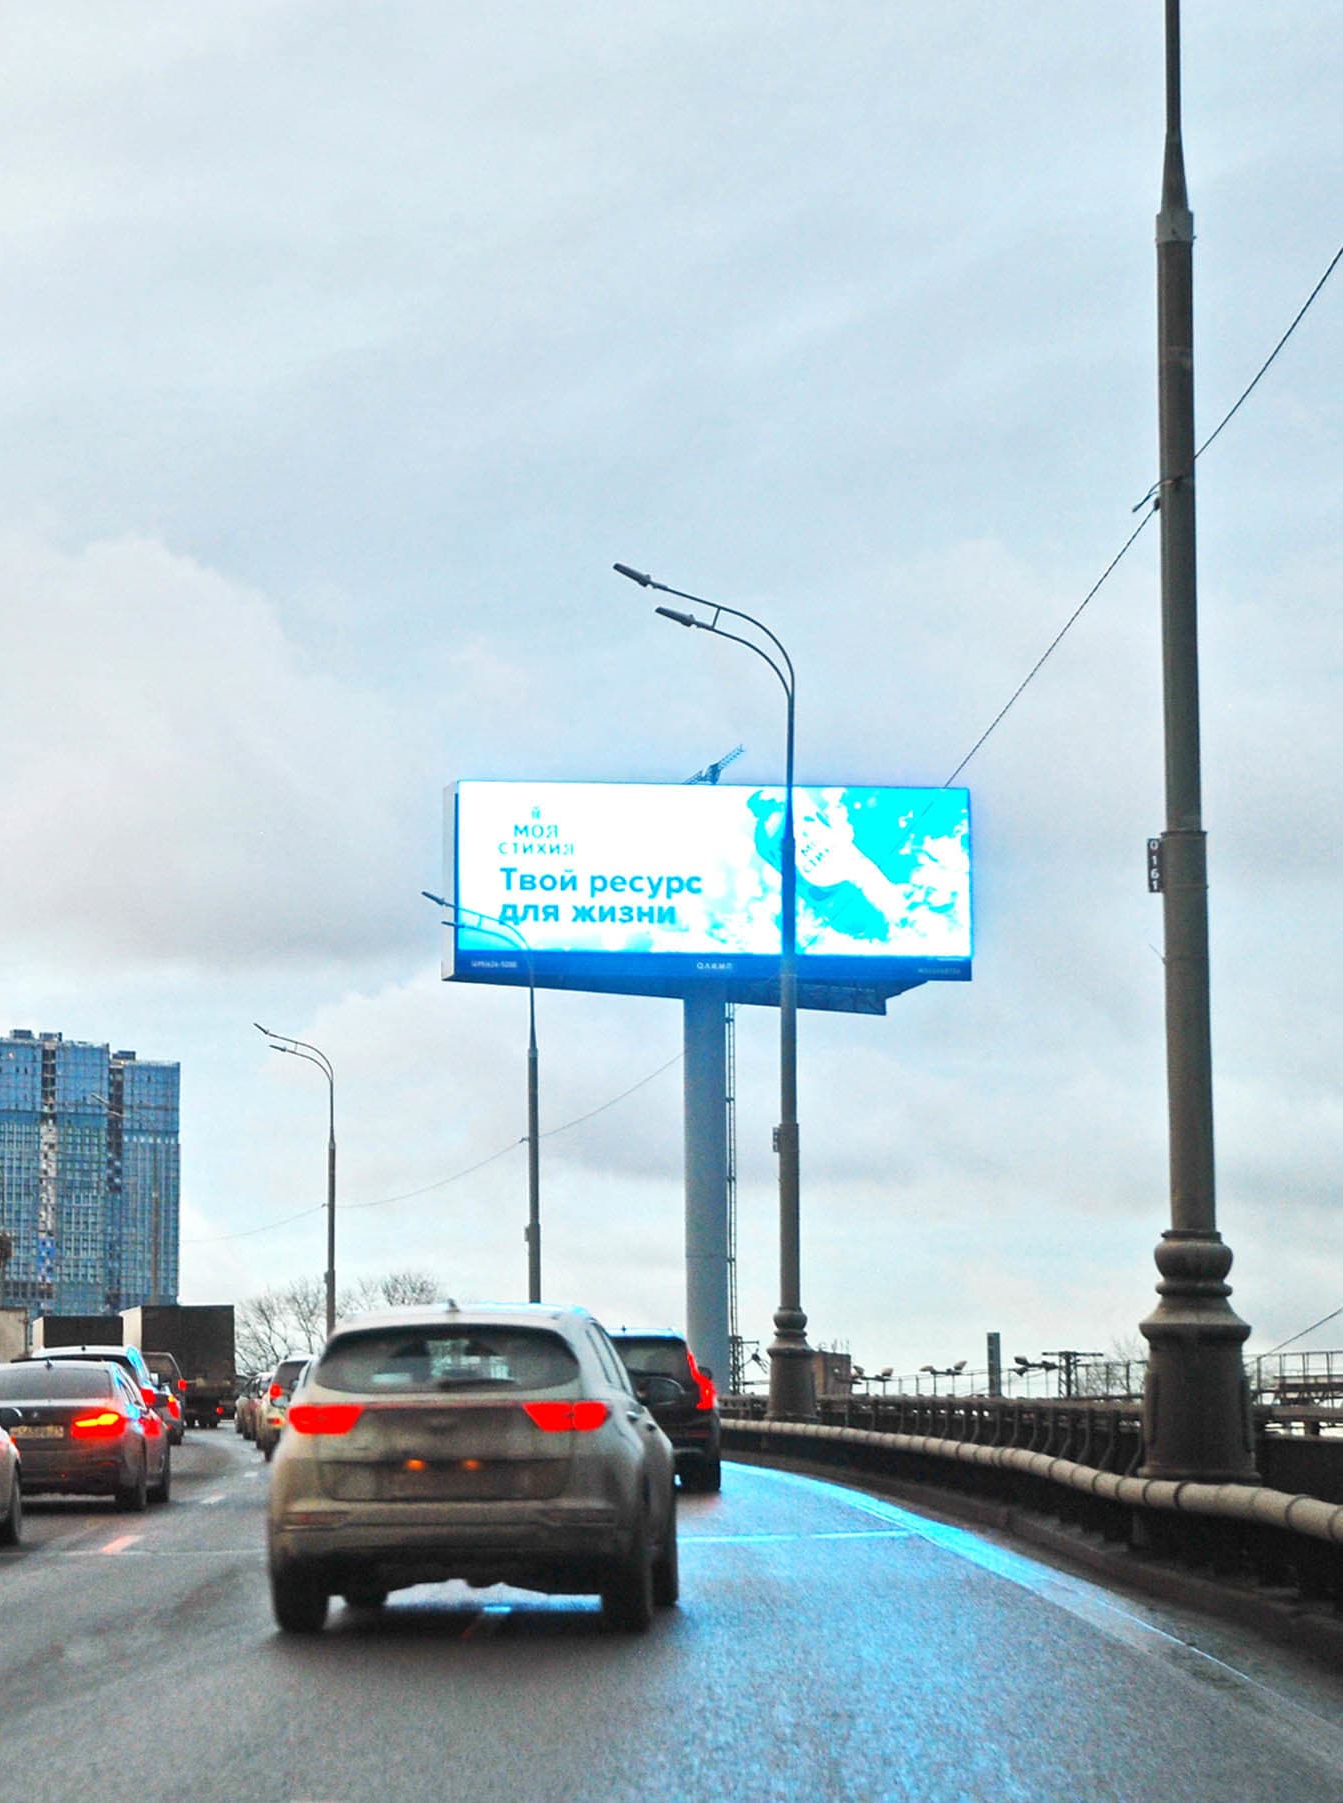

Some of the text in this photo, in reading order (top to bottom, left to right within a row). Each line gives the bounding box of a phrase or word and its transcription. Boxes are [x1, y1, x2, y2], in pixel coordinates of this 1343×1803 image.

[513, 824, 558, 839] МОЯ
[498, 841, 574, 856] СТИХИЯ
[499, 867, 704, 900] Твой ресурс
[499, 903, 678, 926] для жизни
